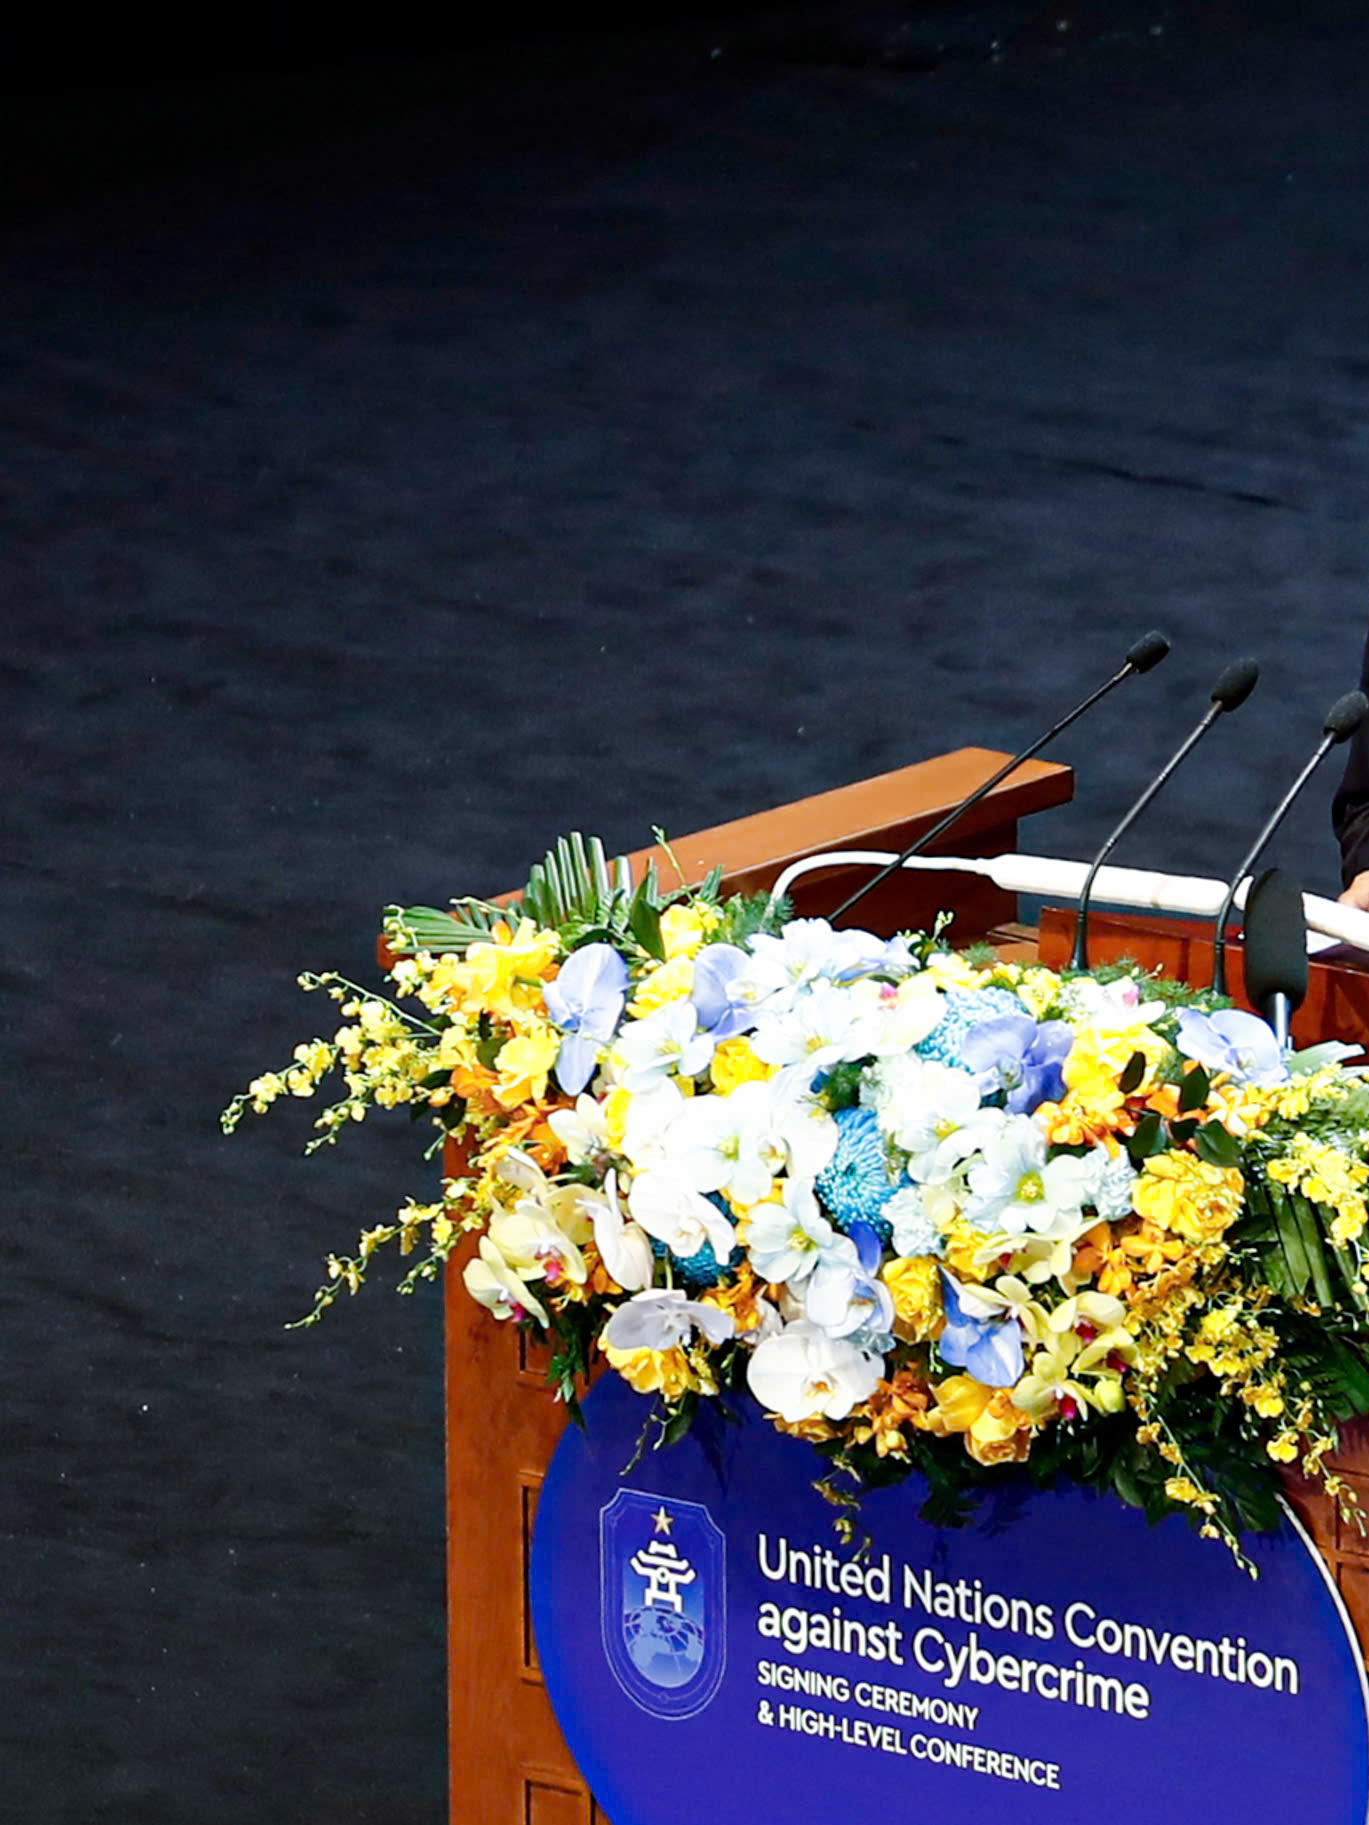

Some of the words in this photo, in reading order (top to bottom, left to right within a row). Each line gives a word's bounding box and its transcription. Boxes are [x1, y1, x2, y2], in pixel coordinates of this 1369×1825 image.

[758, 1602, 904, 1666] against
[913, 1627, 1150, 1719] Cybercrime
[759, 1533, 891, 1604] United
[903, 1564, 1054, 1640] Nations
[1064, 1602, 1298, 1695] Convention
[757, 1660, 850, 1702] SIGNING
[854, 1682, 979, 1731] CEREMONY
[757, 1700, 774, 1726] &
[779, 1704, 908, 1755] HIGH-LEVEL
[910, 1733, 1060, 1790] CONFERENCE
